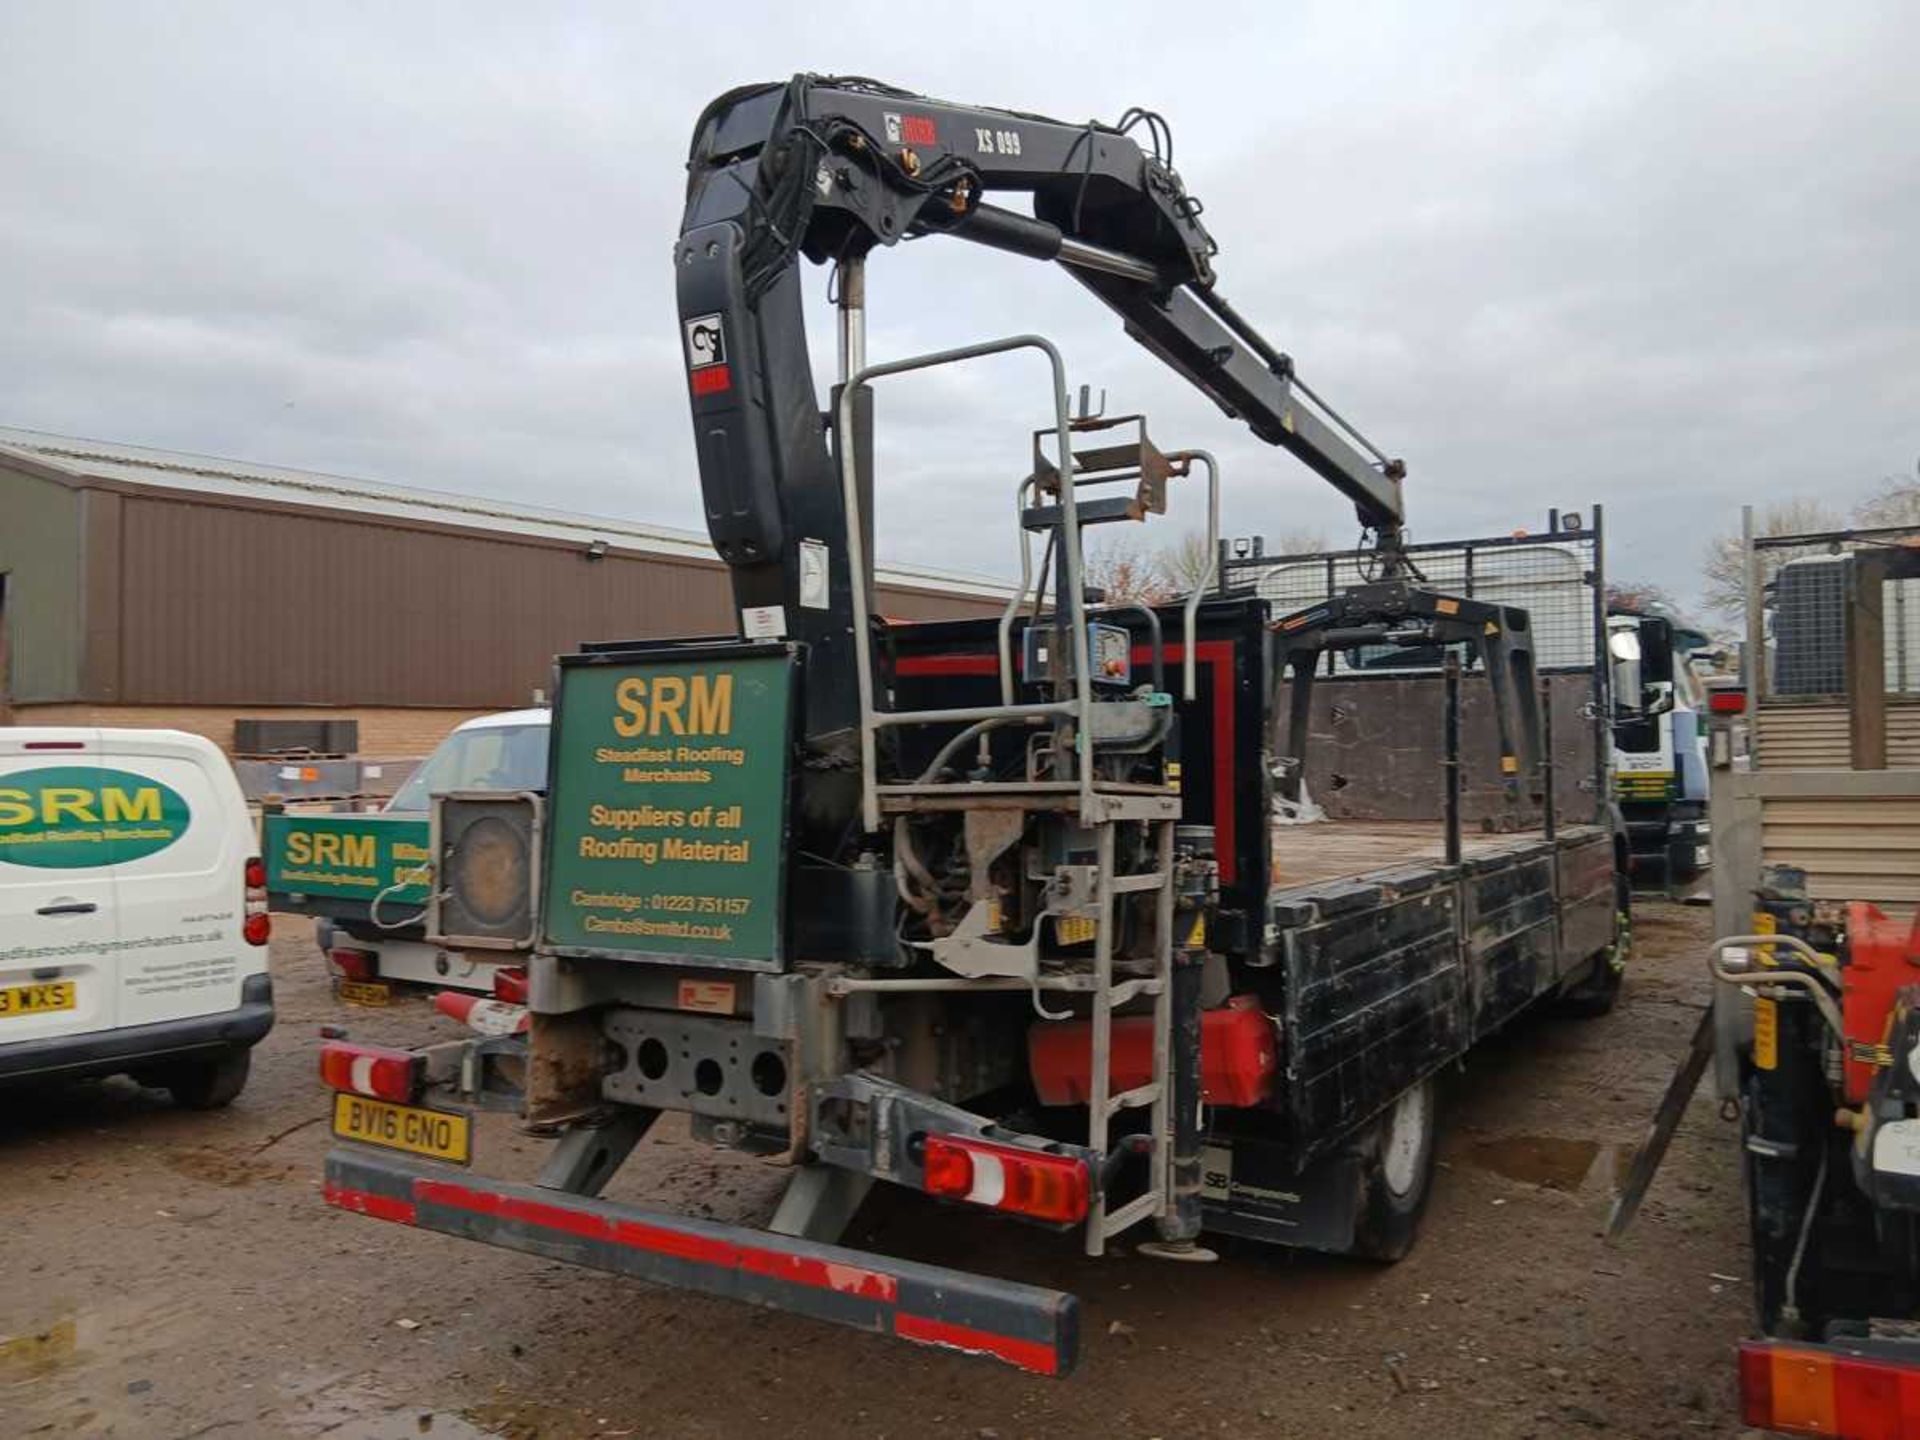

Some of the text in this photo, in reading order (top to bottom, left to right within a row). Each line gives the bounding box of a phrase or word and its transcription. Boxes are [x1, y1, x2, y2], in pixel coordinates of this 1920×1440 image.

[976, 128, 994, 153] XS
[613, 674, 733, 738] SRM
[595, 747, 744, 766] Steadfast Roofing
[623, 768, 713, 783] Merchants
[0, 787, 162, 825] SRM
[590, 805, 742, 830] Suppliers of all
[286, 831, 377, 868] SRM
[579, 836, 749, 864] Roofing Material
[572, 890, 641, 912] Cambridge
[652, 894, 694, 911] 01223
[698, 896, 750, 915] 751157
[20, 986, 65, 1010] WXS
[349, 1102, 450, 1149] BV16 GNO
